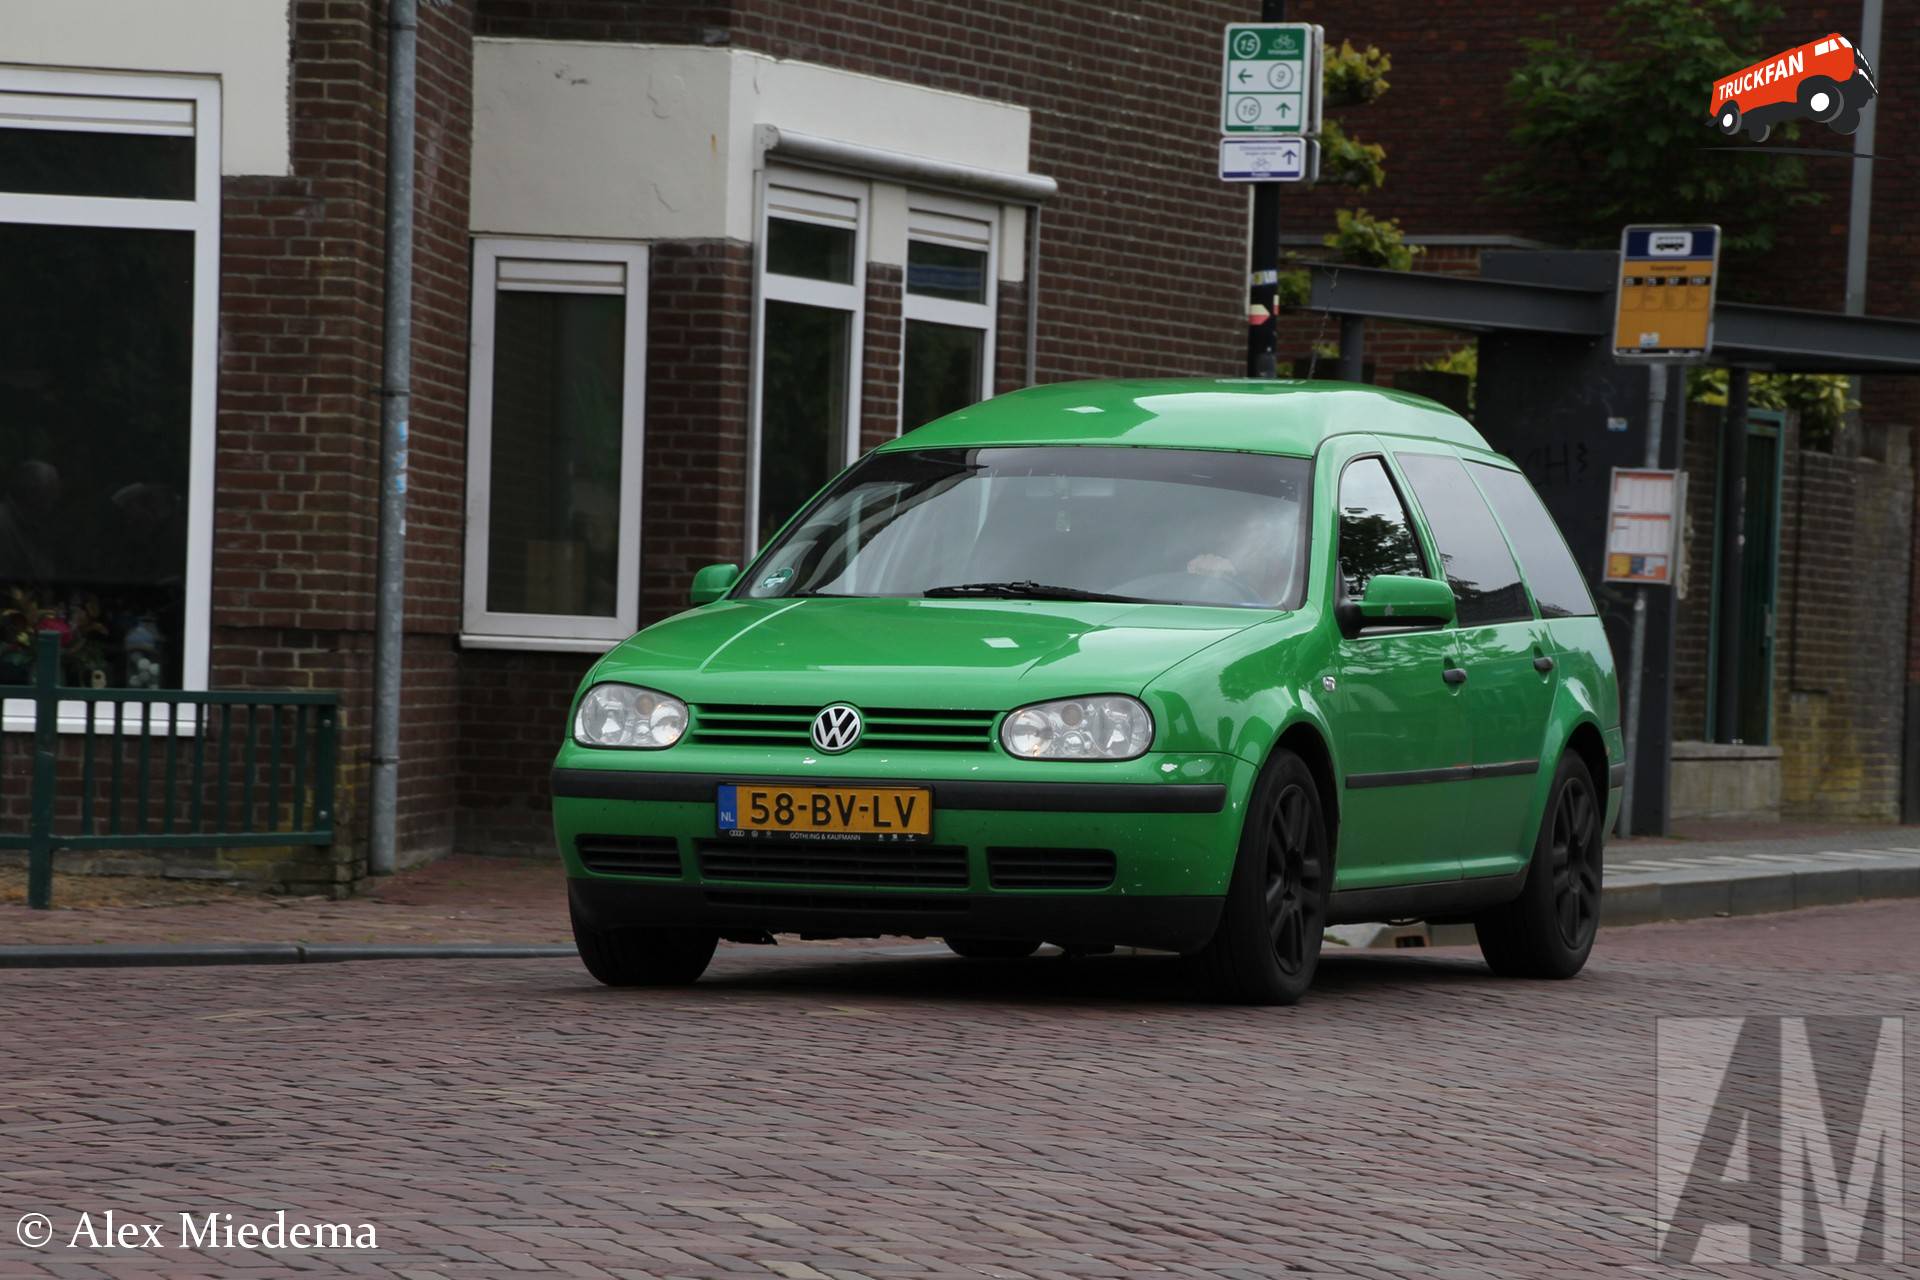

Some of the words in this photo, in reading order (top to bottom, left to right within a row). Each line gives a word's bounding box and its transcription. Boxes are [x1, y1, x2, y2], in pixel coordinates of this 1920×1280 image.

[1240, 38, 1256, 51] 15
[1276, 70, 1285, 83] 9
[1242, 104, 1257, 117] 16
[751, 792, 916, 828] 58-BV-LV
[720, 811, 735, 823] NL
